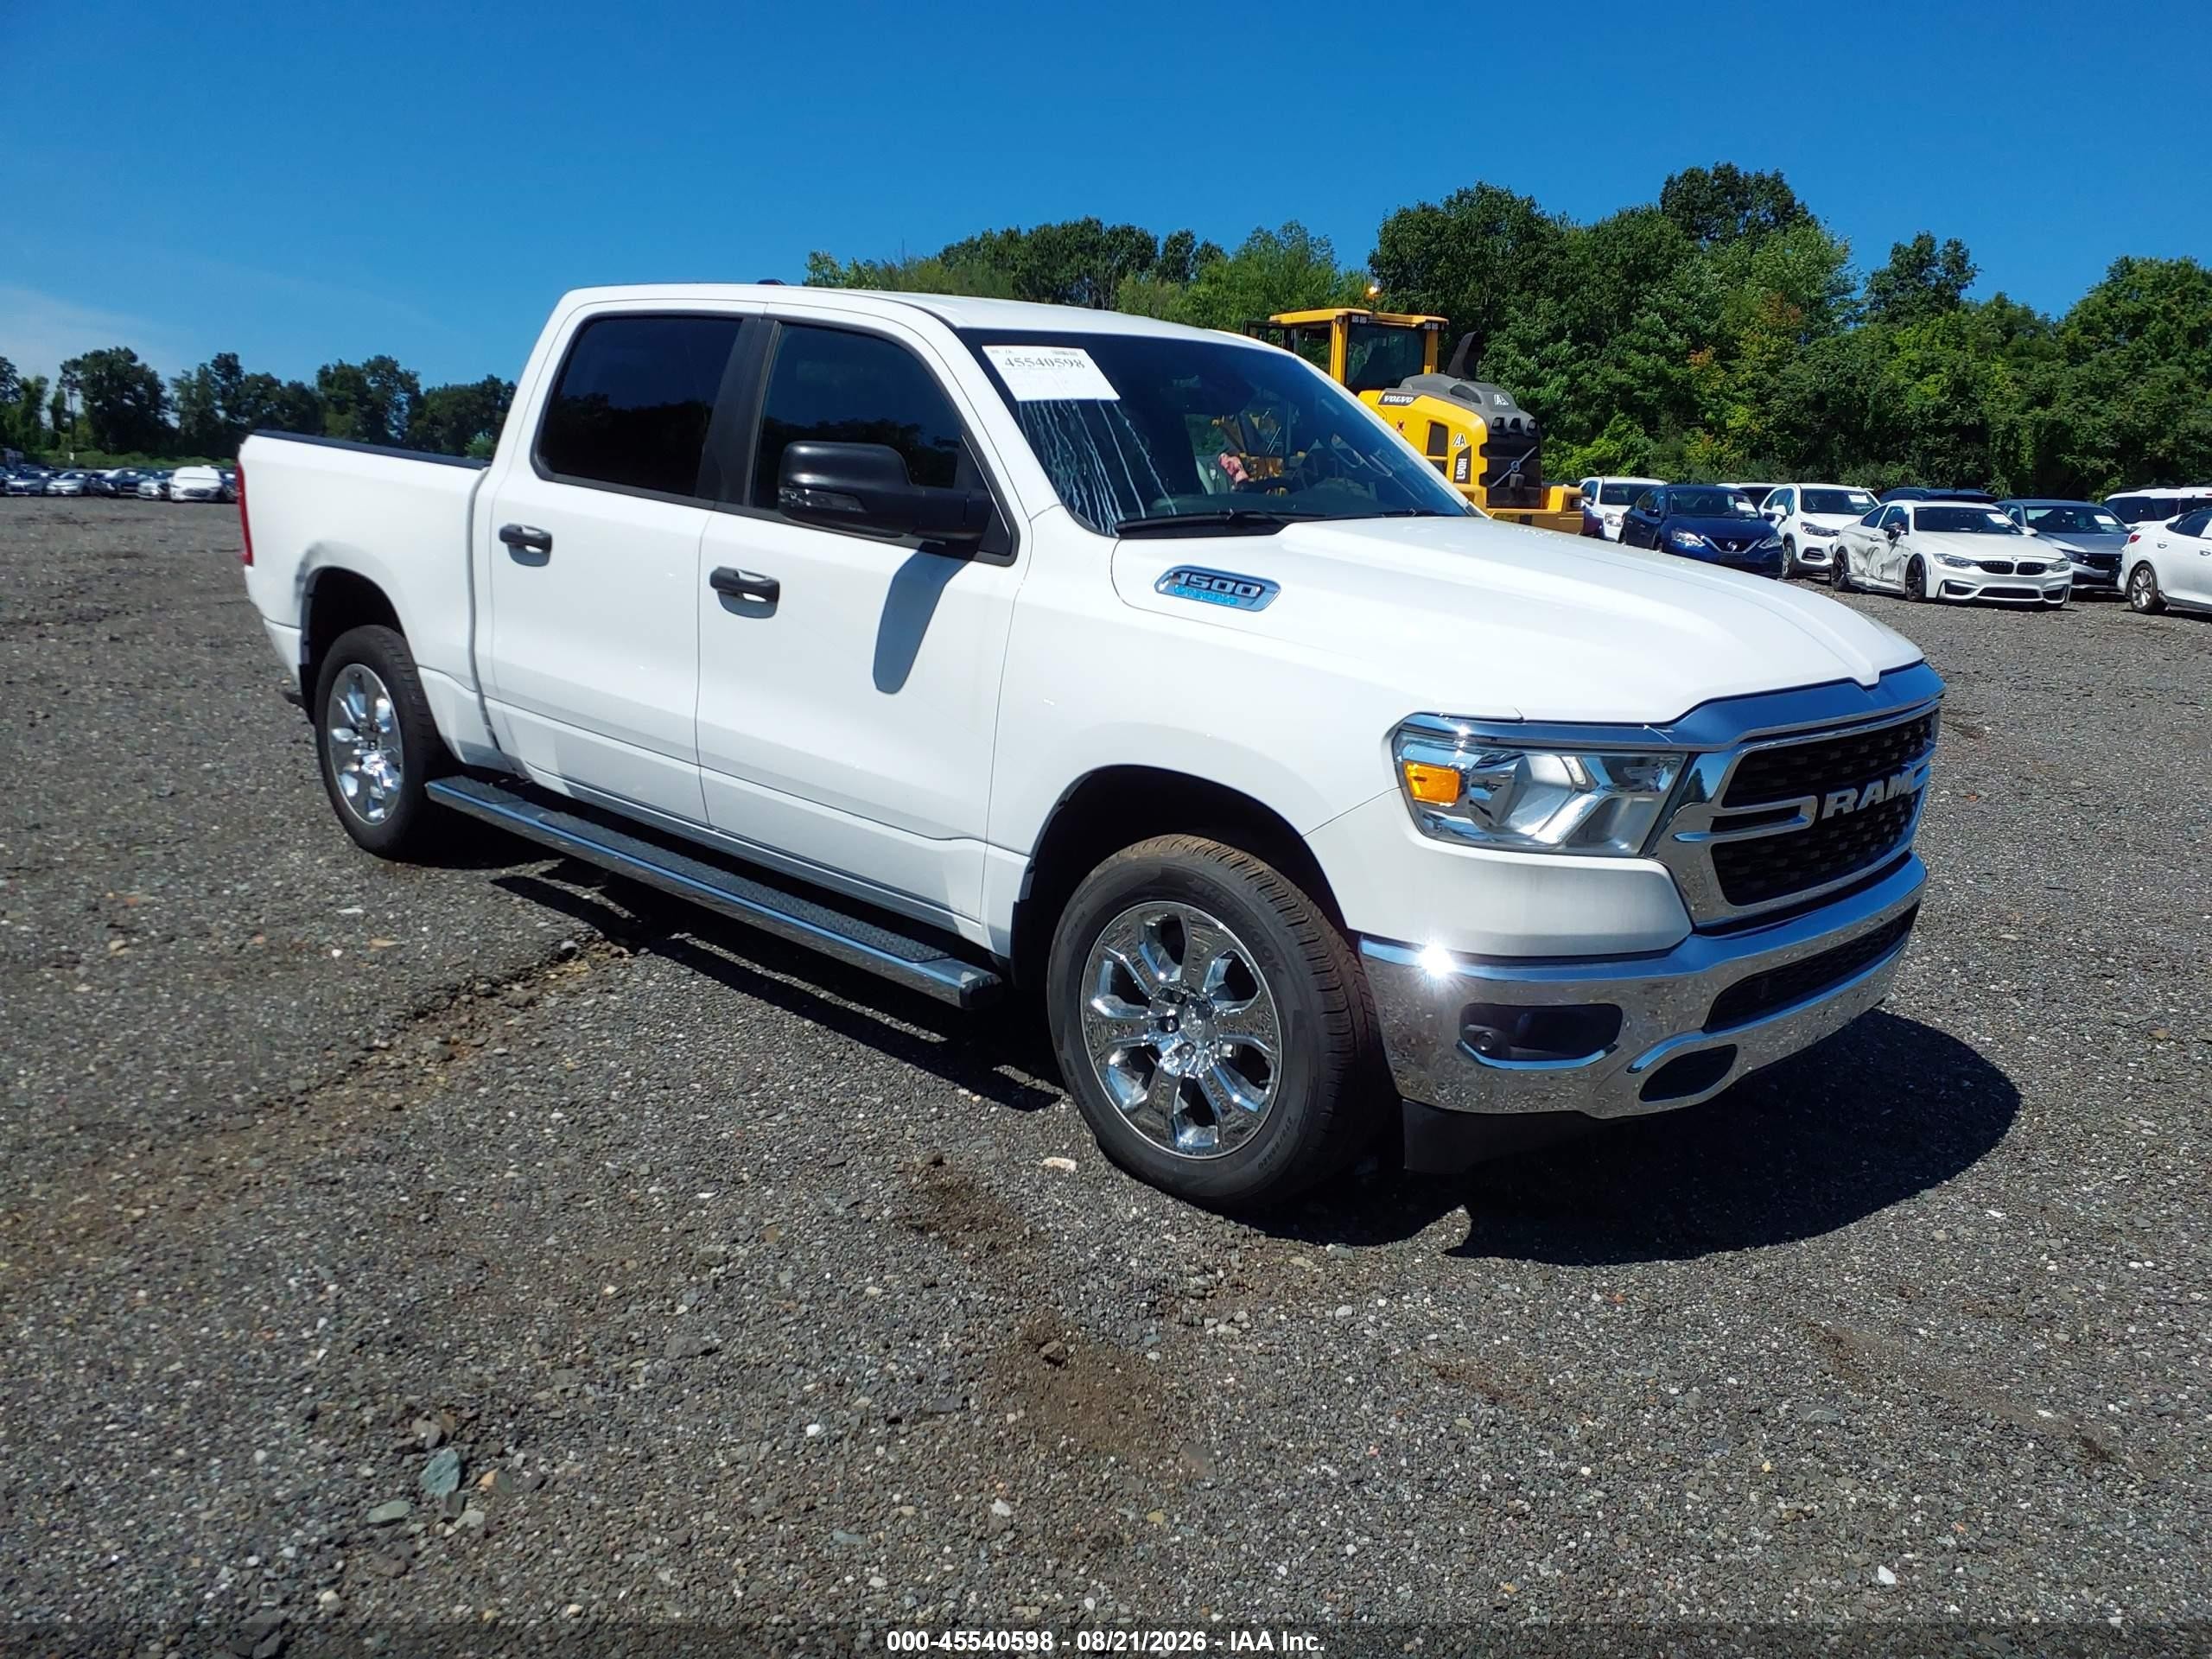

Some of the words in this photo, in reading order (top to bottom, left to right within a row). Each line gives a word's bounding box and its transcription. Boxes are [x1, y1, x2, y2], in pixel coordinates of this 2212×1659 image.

[1004, 357, 1086, 370] 45540598
[1383, 395, 1414, 404] VOLVO
[1455, 457, 1468, 480] L90H
[1172, 572, 1262, 598] 1500
[1821, 769, 1916, 821] RAM
